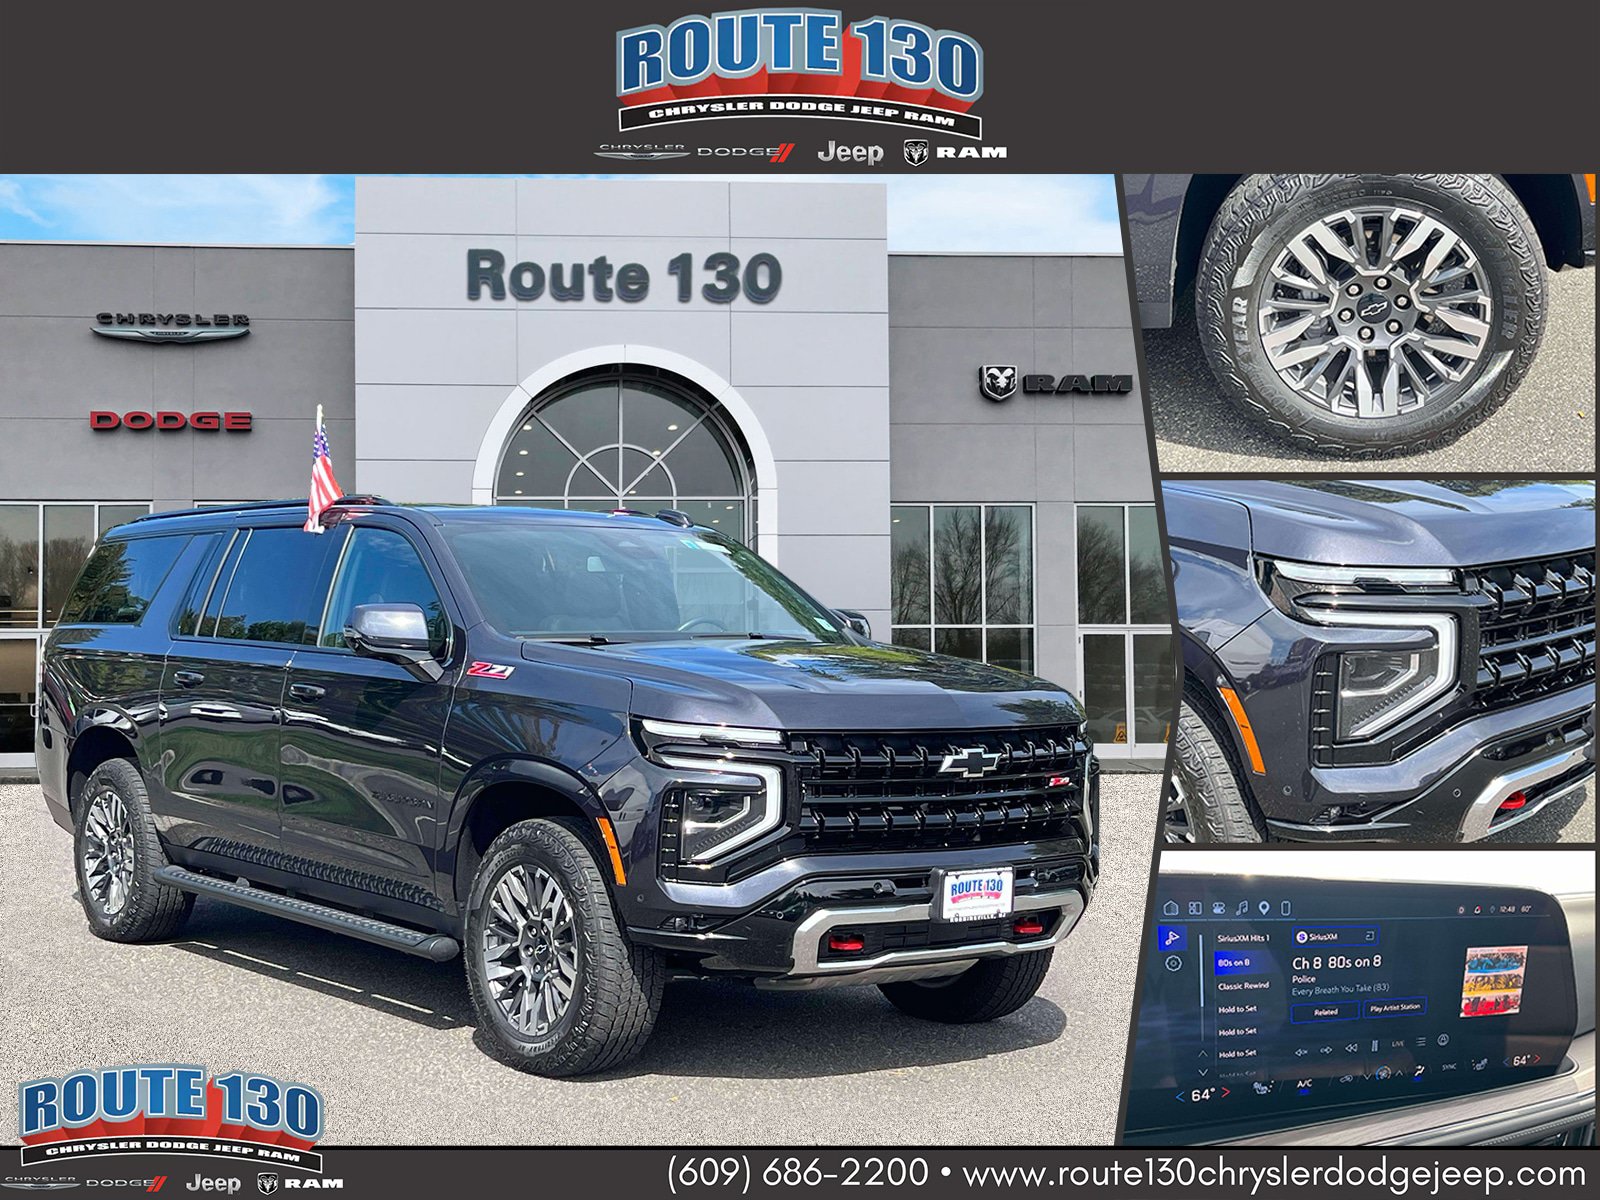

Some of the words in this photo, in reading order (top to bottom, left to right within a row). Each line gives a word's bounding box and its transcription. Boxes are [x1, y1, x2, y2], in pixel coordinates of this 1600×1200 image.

[467, 248, 650, 303] Route
[668, 252, 782, 304] 130
[95, 312, 250, 327] CHRYSLER
[1023, 373, 1133, 394] RAM
[90, 411, 252, 432] DODGE
[466, 661, 516, 680] Z71
[951, 879, 983, 896] ROUTE
[986, 878, 1003, 892] 130
[1499, 905, 1516, 913] 12:48
[1217, 934, 1249, 943] SiriusXM
[1250, 934, 1265, 942] Hits
[1309, 932, 1338, 941] SiriusXM
[1218, 959, 1233, 967] 80s
[1244, 958, 1250, 966] 8
[1292, 957, 1310, 970] Ch
[1313, 956, 1322, 969] 8
[1328, 956, 1352, 969] 80s
[1354, 958, 1370, 968] on
[1373, 955, 1382, 967] 8
[1292, 974, 1316, 984] Police
[1218, 982, 1243, 991] Classic
[1244, 981, 1270, 989] Rewind
[1292, 987, 1314, 997] Every
[1315, 985, 1340, 995] Breath
[1341, 985, 1354, 993] You
[1355, 983, 1372, 992] Take
[1373, 983, 1390, 993] (83)
[1218, 1006, 1235, 1014] Hold
[1237, 1005, 1245, 1013] to
[1246, 1004, 1257, 1012] Set
[1314, 1008, 1338, 1016] Related
[1370, 1005, 1383, 1013] Play
[1383, 1004, 1399, 1012] Artist
[1401, 1003, 1421, 1011] Station
[1218, 1028, 1235, 1036] Hold
[1513, 1054, 1531, 1066] 64°
[1297, 1078, 1313, 1088] A/C
[1191, 1087, 1216, 1102] 64°
